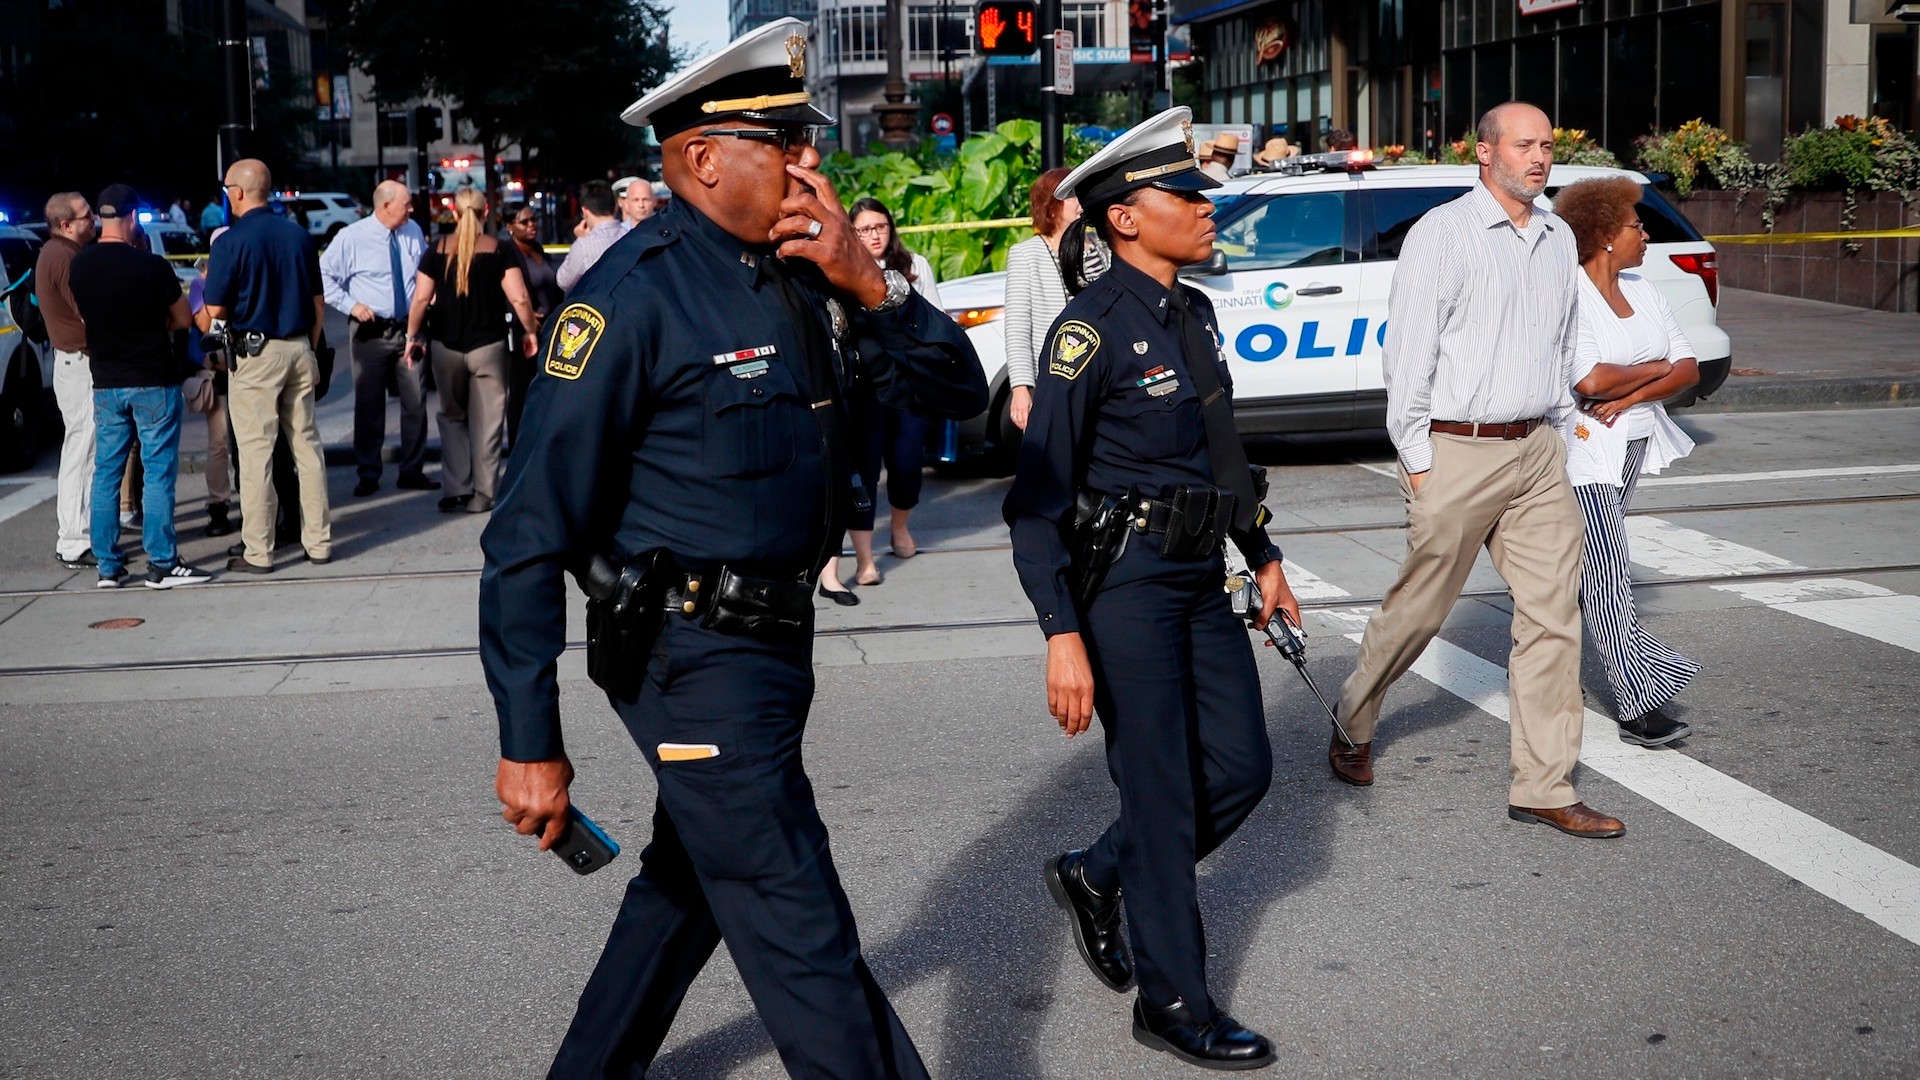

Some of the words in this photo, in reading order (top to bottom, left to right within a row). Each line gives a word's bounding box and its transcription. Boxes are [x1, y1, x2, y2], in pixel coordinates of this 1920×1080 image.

[1017, 11, 1033, 43] 4
[1073, 49, 1094, 61] SIC
[1212, 296, 1263, 309] CINNATI
[1219, 318, 1388, 362] OLI
[549, 360, 578, 375] POLICE
